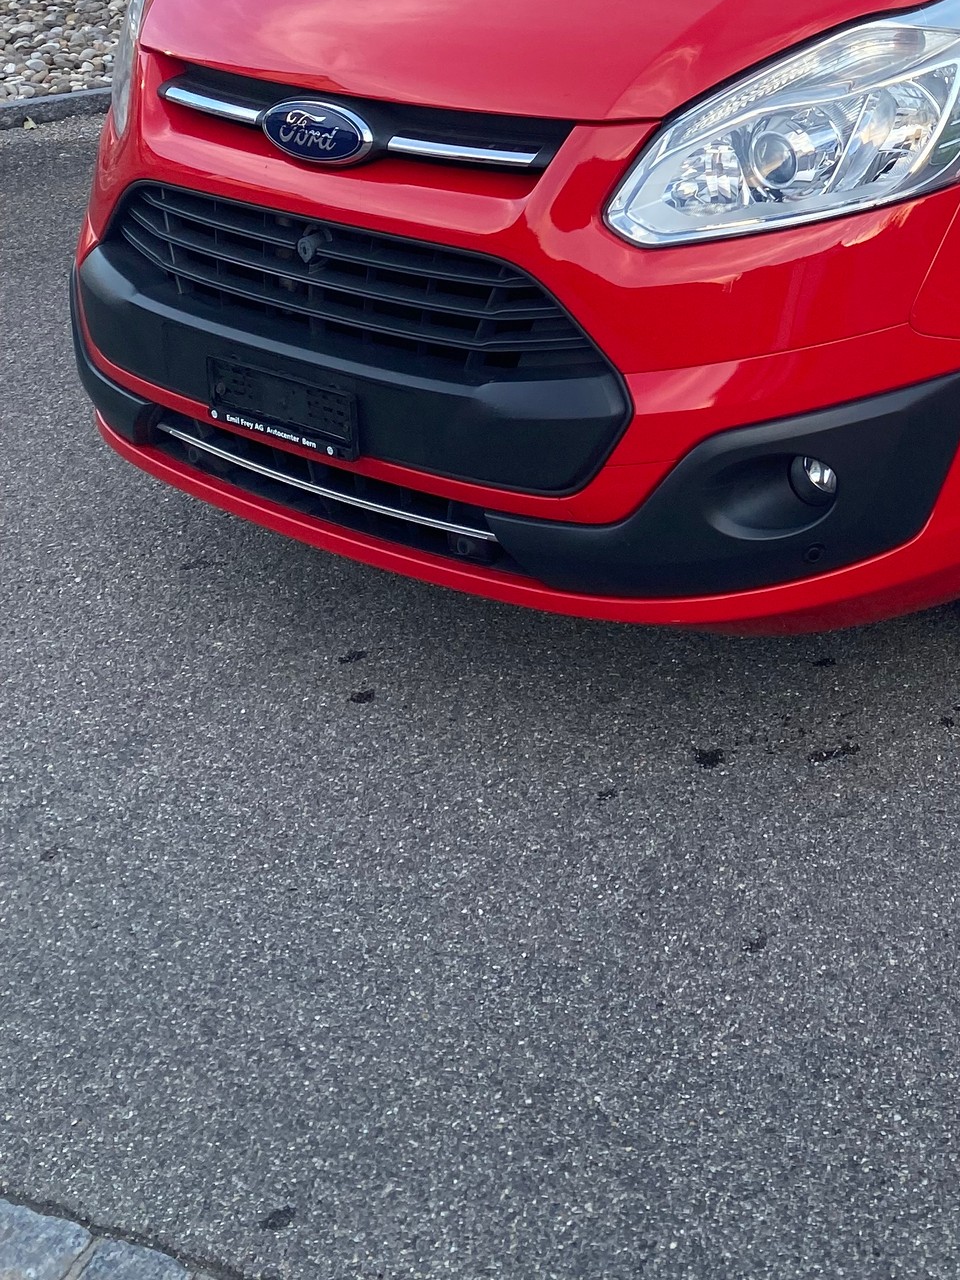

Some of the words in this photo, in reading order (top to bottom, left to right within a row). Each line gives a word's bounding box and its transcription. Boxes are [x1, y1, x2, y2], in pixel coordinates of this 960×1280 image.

[279, 109, 340, 151] Ford
[226, 414, 240, 424] Emil
[240, 419, 254, 430] Frey
[254, 422, 264, 432] AG
[266, 426, 300, 442] Autocenter
[301, 437, 317, 449] Bern
